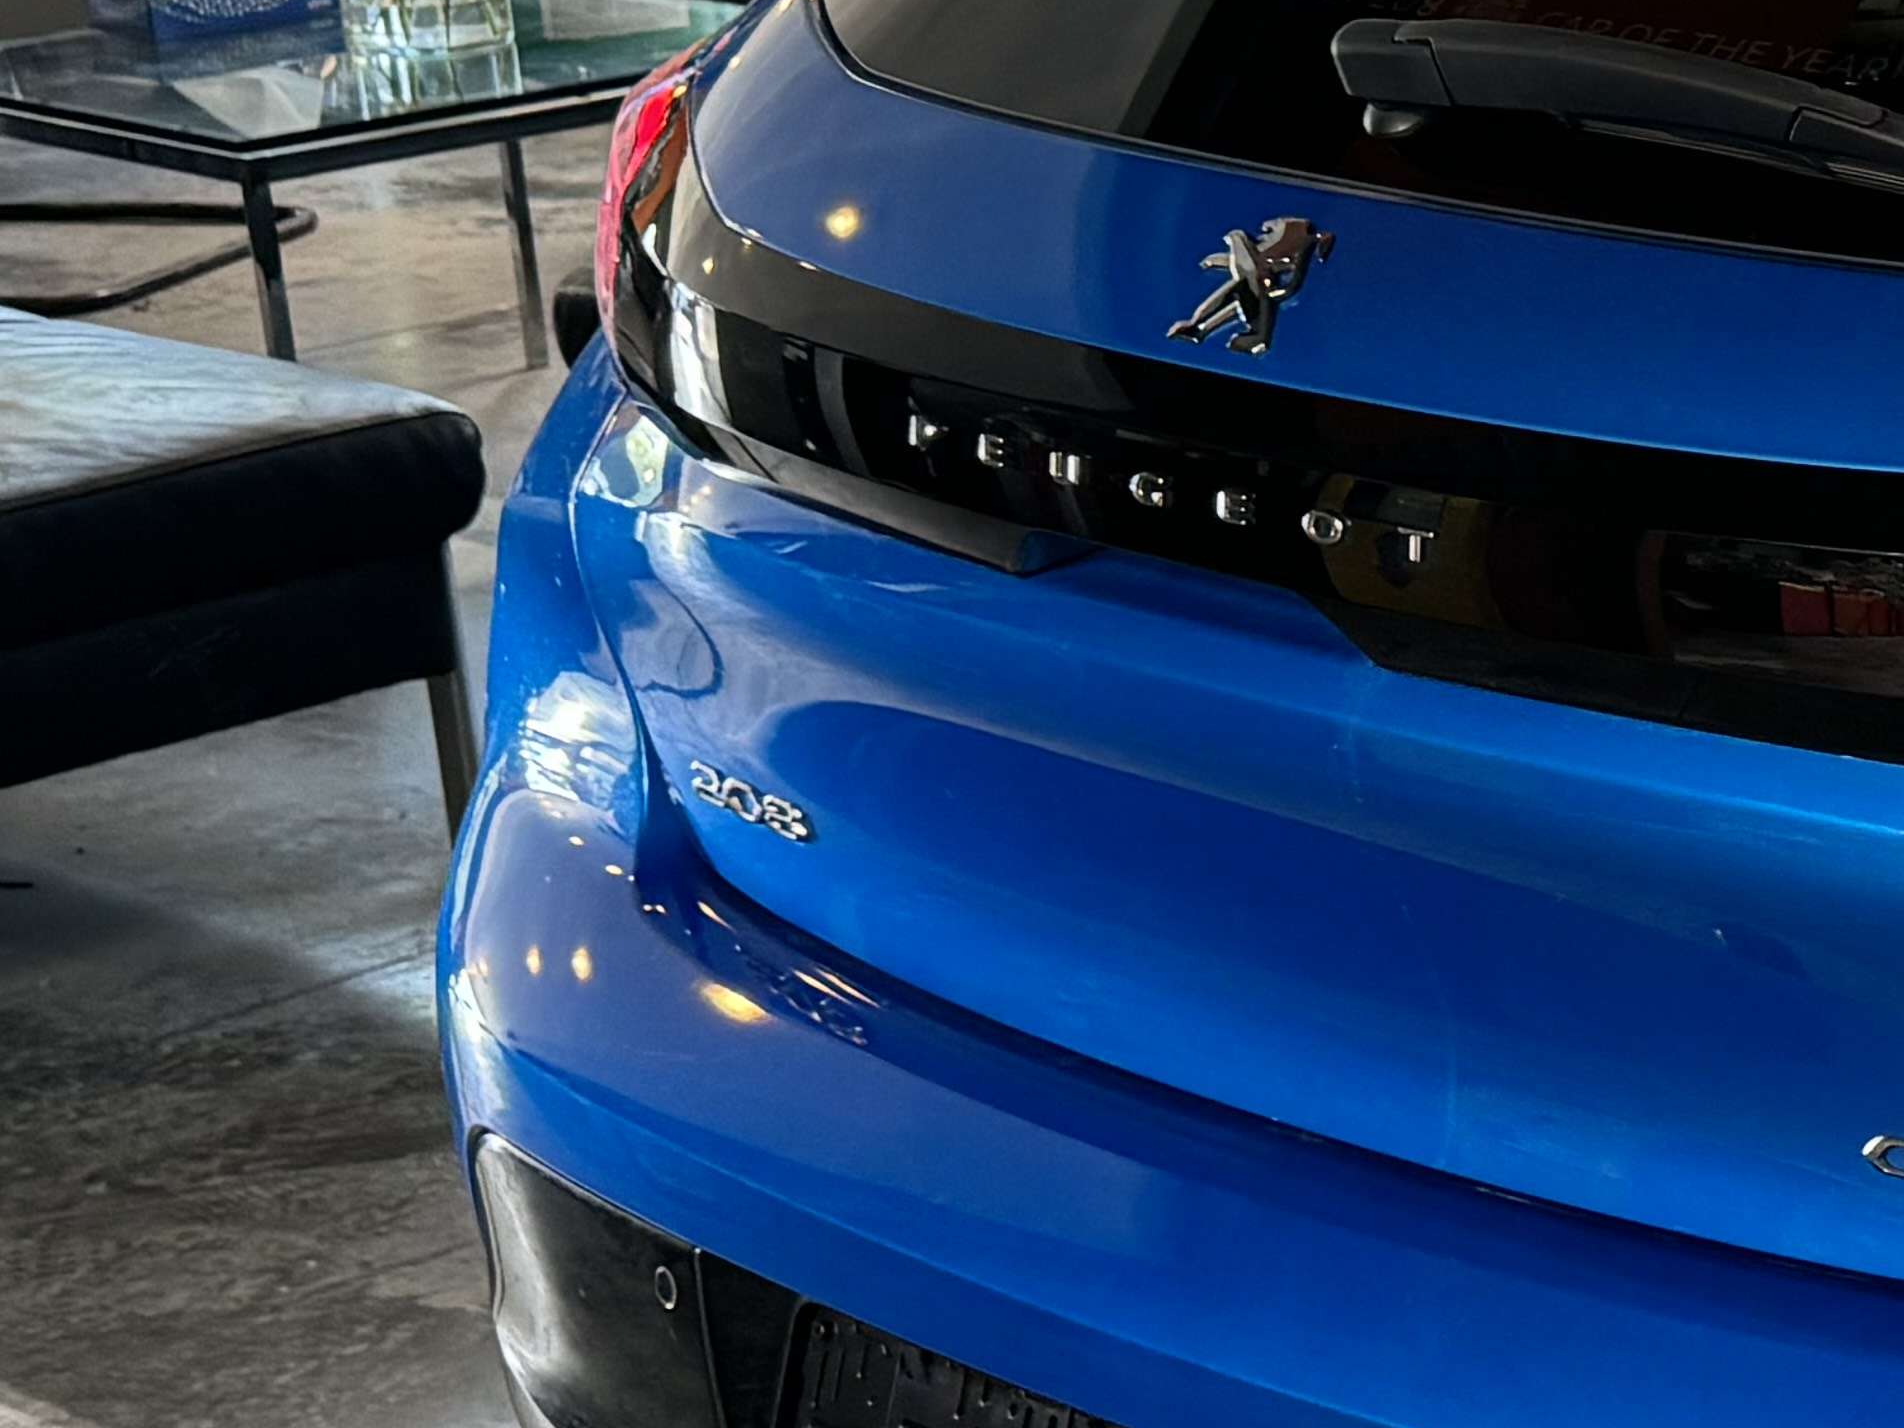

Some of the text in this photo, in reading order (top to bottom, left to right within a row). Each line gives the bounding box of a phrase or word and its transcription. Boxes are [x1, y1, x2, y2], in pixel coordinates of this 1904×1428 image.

[1690, 29, 1776, 65] THE
[907, 412, 1435, 564] PEUGEOT
[690, 759, 812, 842] 208
